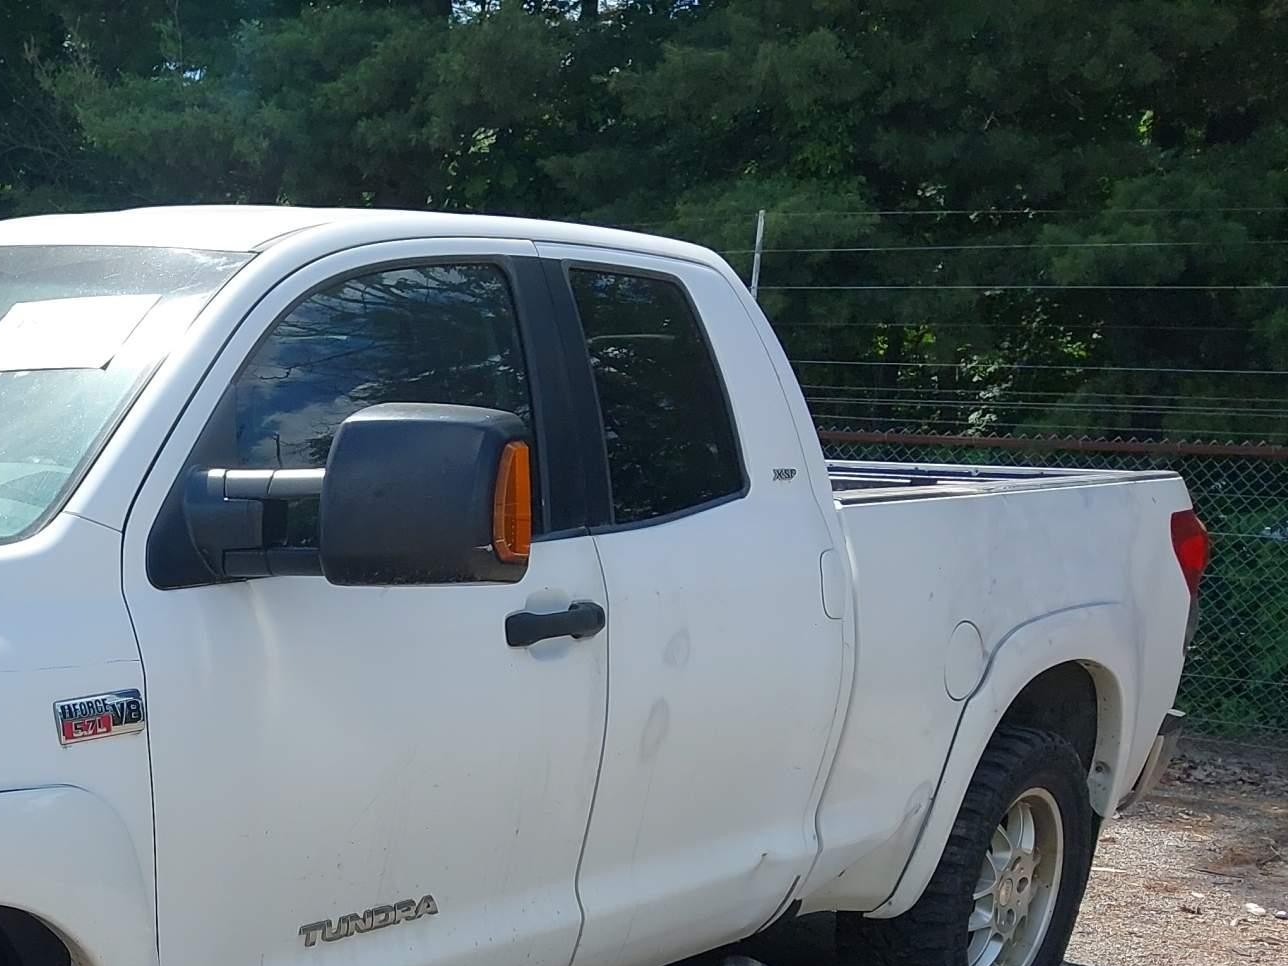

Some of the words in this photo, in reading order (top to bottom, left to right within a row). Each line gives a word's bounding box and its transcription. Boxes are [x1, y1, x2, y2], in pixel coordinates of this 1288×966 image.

[772, 468, 797, 481] XSP
[110, 699, 142, 727] V8
[72, 716, 108, 737] 5.7L
[298, 894, 440, 947] TUNDRA
